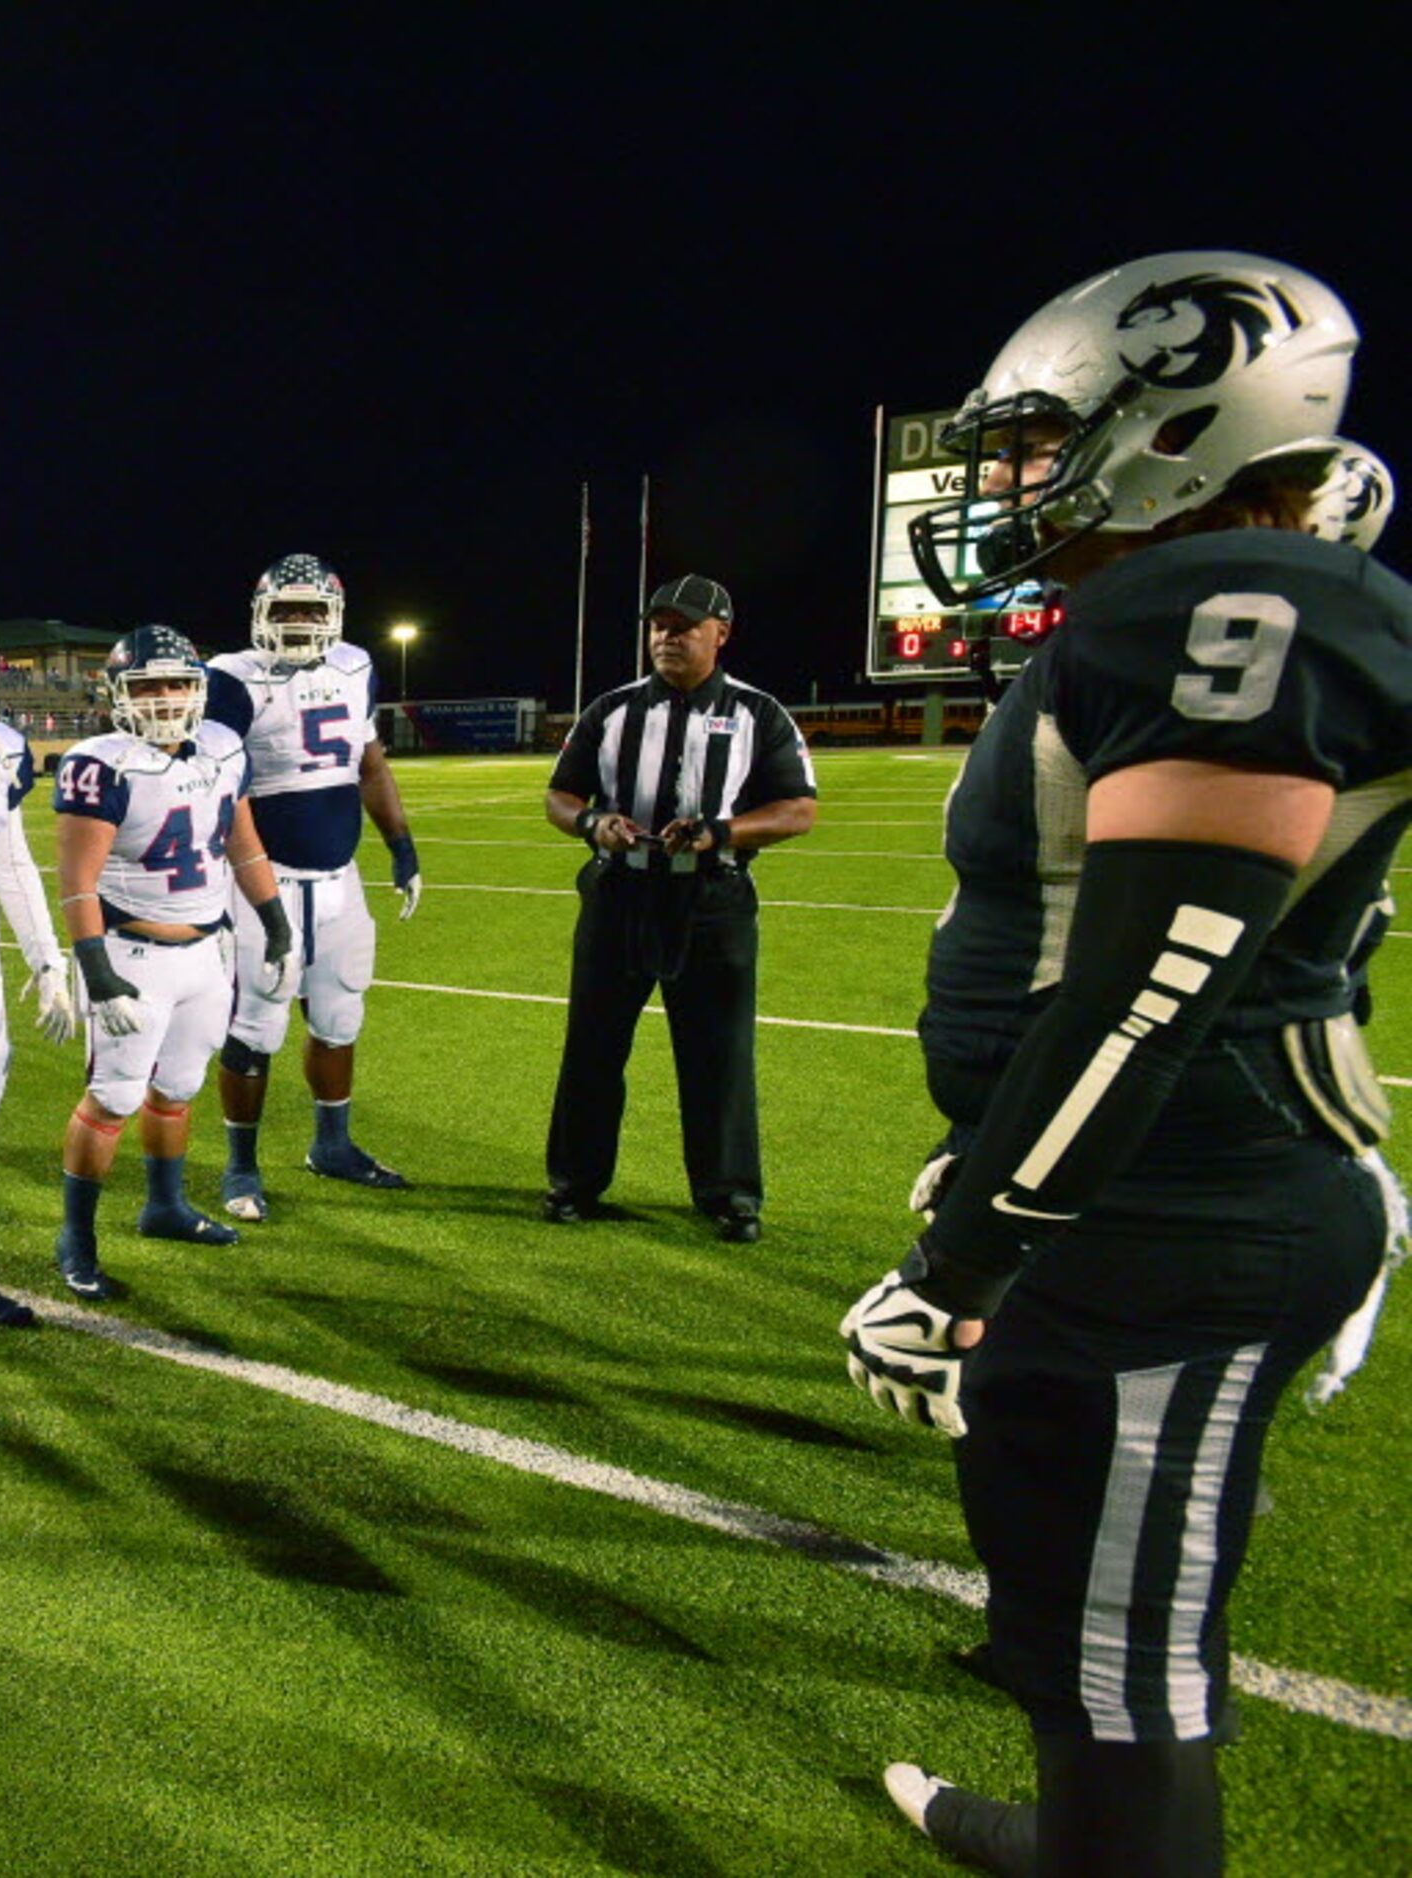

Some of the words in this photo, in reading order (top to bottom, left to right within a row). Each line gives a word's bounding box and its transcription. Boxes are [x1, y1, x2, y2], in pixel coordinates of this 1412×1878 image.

[1170, 592, 1299, 722] 9
[300, 702, 351, 773] 5
[59, 761, 102, 805] 44
